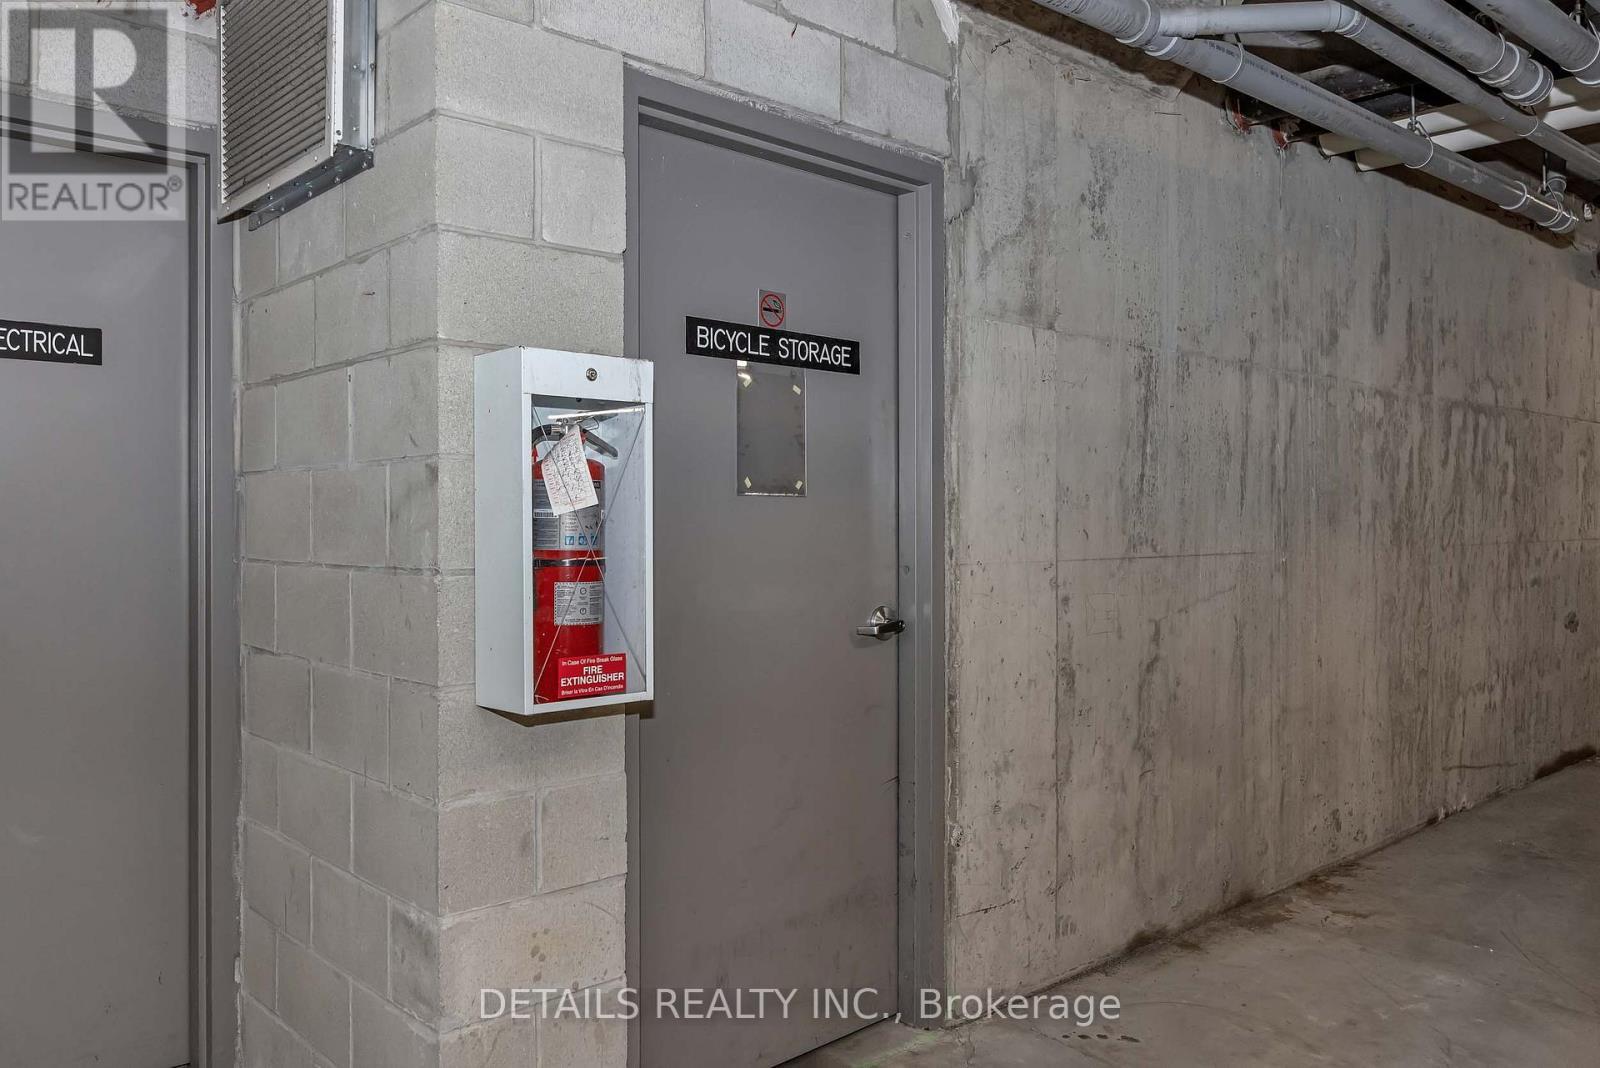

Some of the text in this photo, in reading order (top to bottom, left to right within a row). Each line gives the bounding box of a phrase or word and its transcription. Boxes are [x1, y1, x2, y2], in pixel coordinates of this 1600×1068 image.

[696, 325, 852, 367] BICYCLE STORAGE
[583, 665, 603, 675] FIRE
[561, 672, 624, 687] EXTINGUISHER
